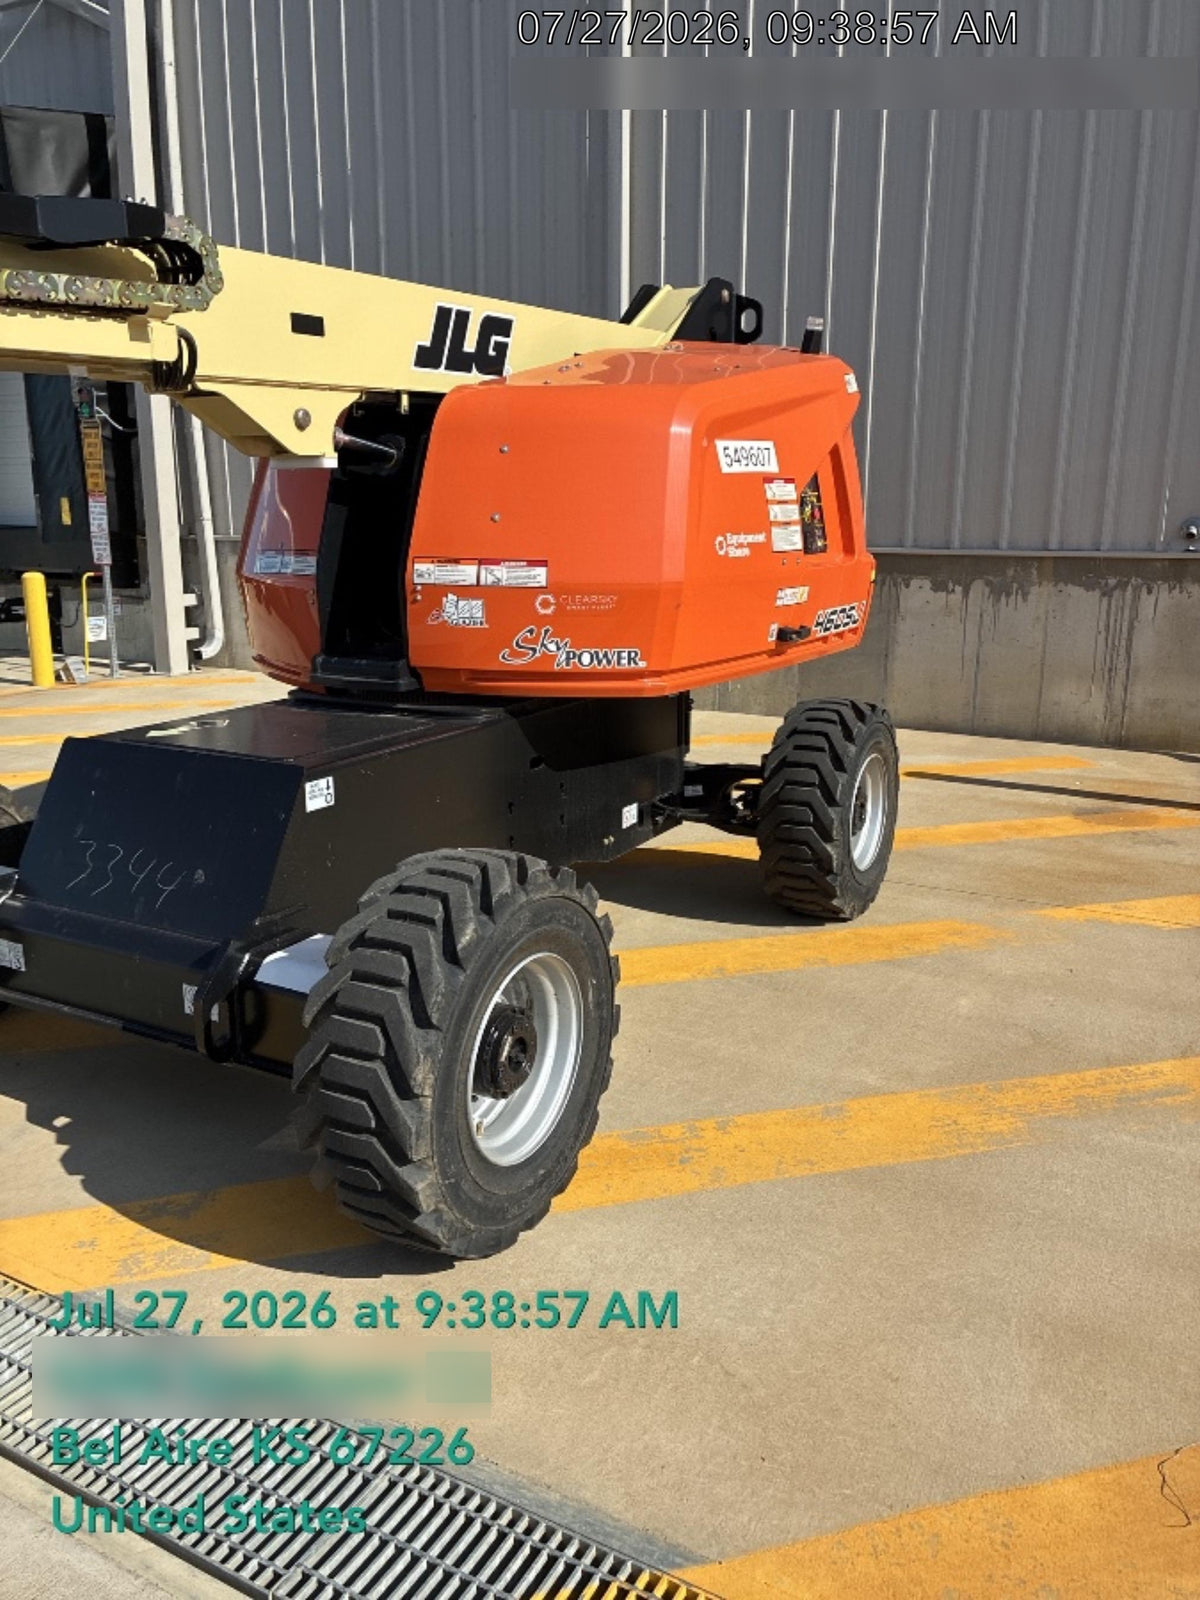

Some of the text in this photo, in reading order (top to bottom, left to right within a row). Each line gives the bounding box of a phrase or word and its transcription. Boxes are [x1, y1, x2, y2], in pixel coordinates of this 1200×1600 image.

[413, 304, 514, 377] JLG
[722, 446, 771, 467] 549607
[500, 626, 570, 669] Sky
[564, 649, 642, 668] POWER
